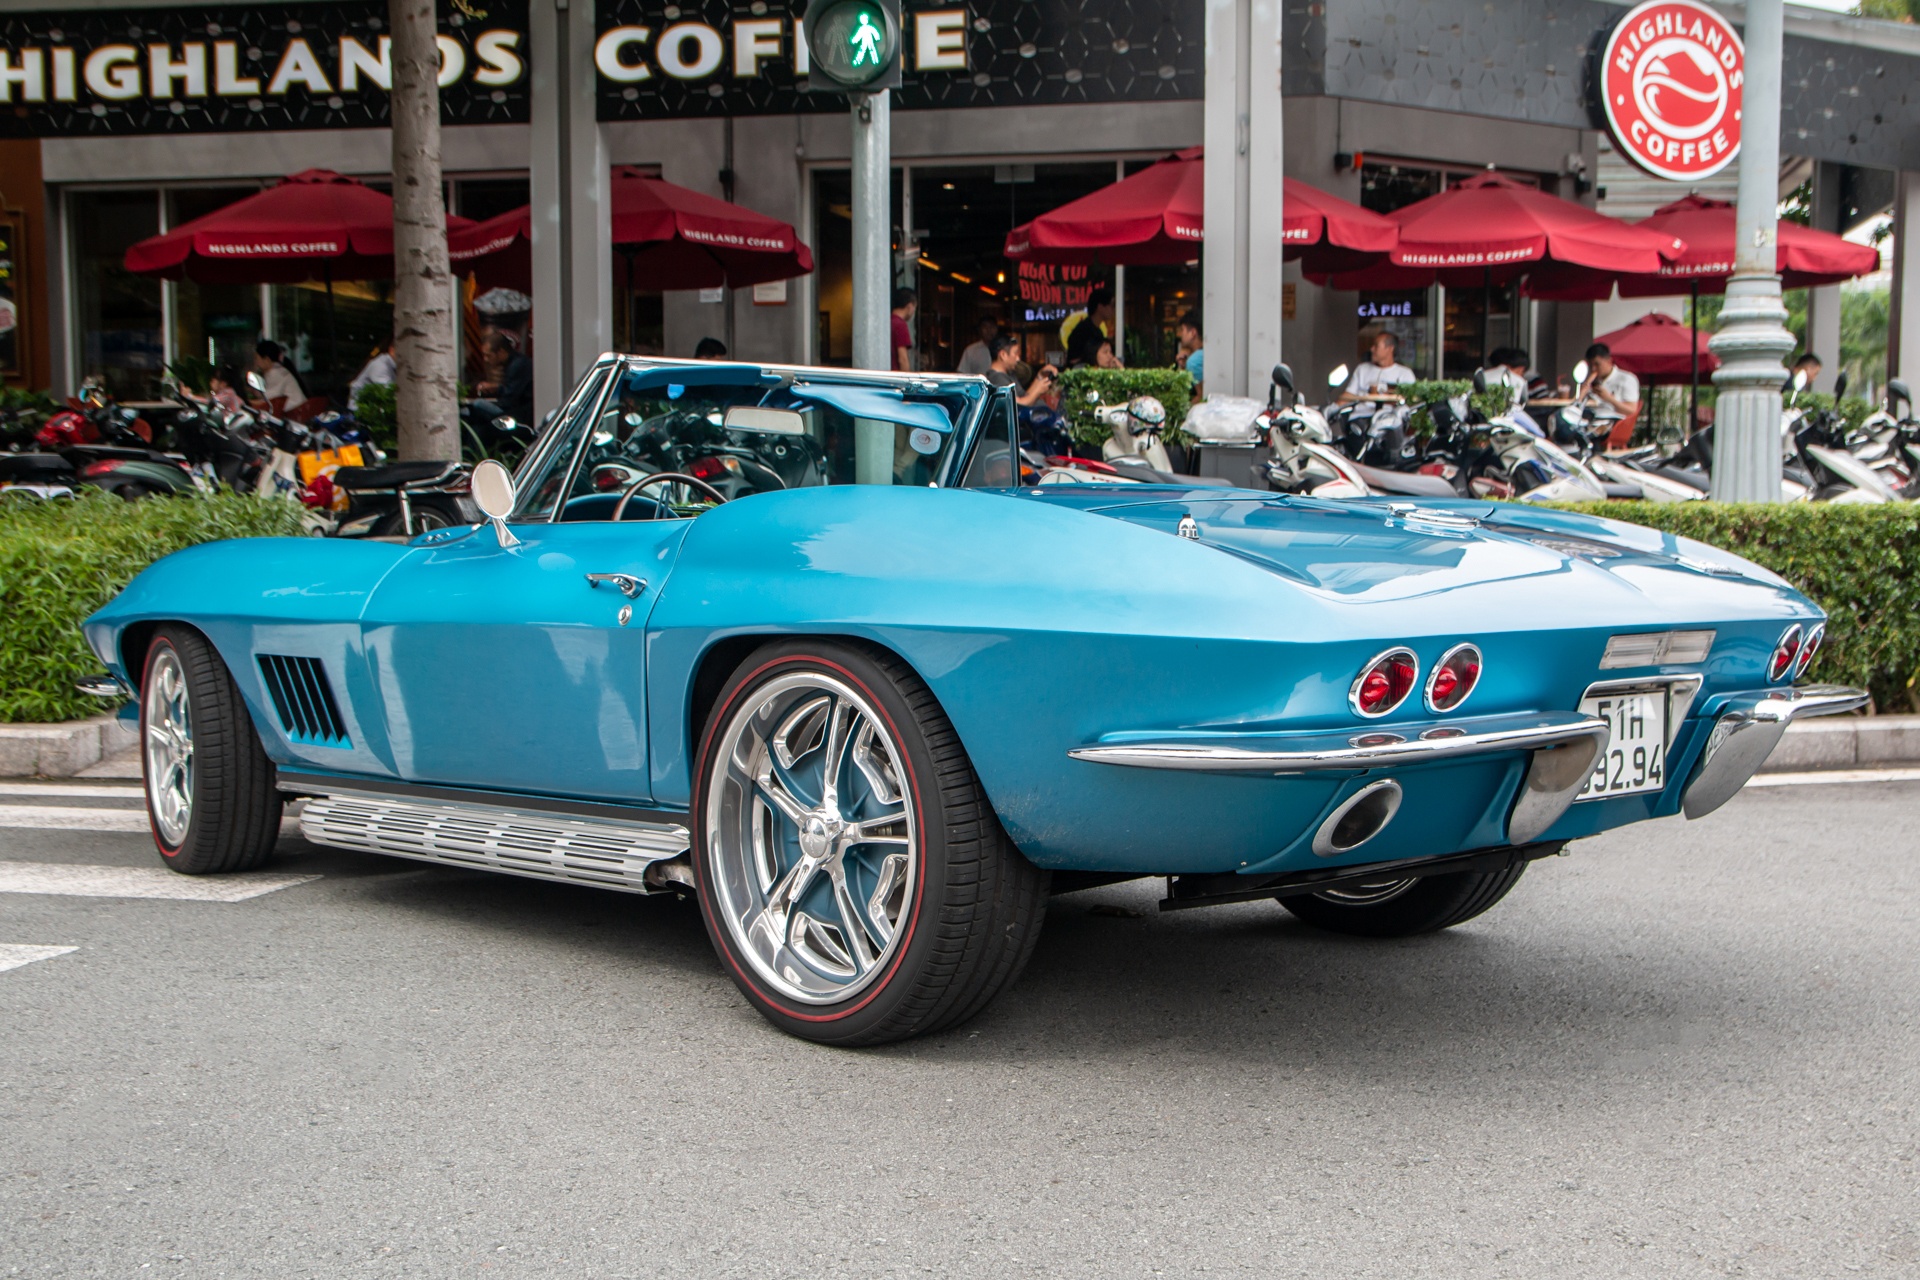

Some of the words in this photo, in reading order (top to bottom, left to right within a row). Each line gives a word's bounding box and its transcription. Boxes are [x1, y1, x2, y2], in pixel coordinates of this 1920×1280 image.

[594, 9, 967, 83] COFE
[1616, 12, 1744, 90] HIGHLANDS
[1631, 119, 1729, 165] COFFEE
[209, 243, 289, 254] HIGHLANDS
[291, 242, 338, 253] COFFEE
[684, 229, 744, 245] HIGHLANDS
[747, 237, 785, 249] COFFEE
[1402, 253, 1484, 264] HIGHLANDS
[1486, 247, 1533, 262] COFFEE
[1598, 697, 1644, 741] 51H
[1579, 744, 1662, 794] 92.94
